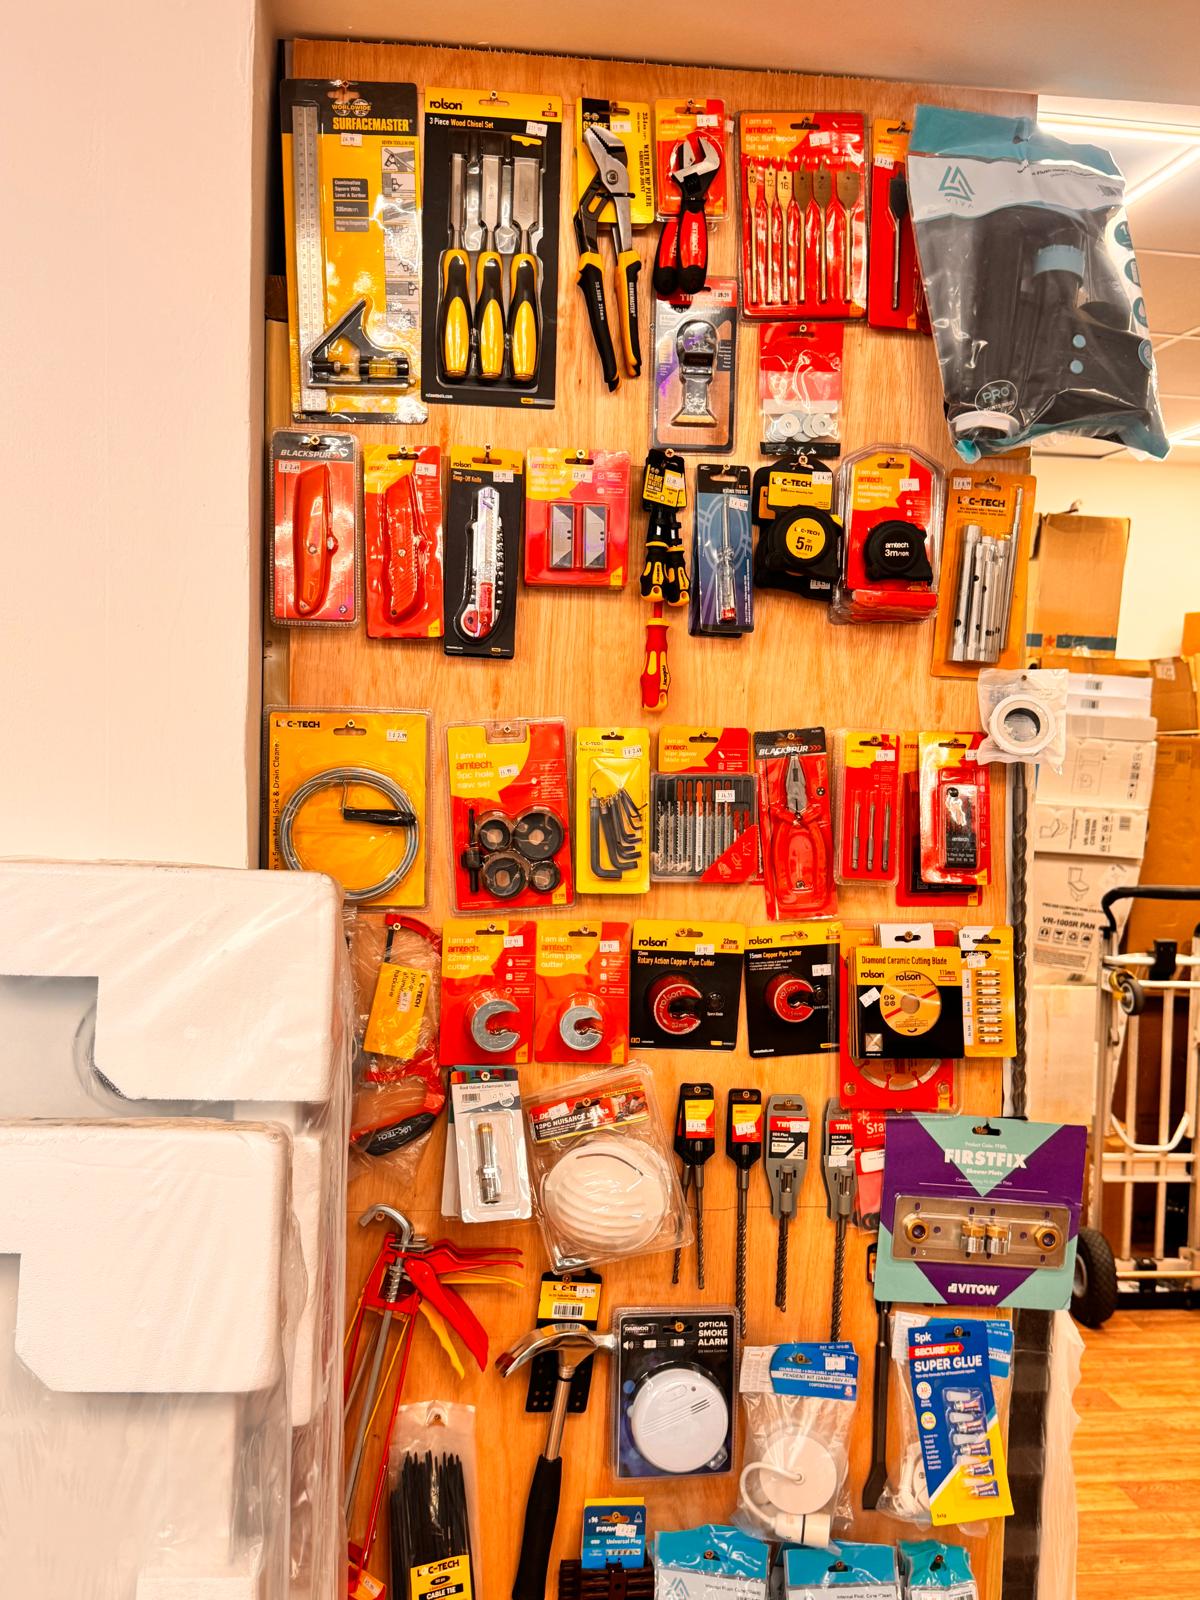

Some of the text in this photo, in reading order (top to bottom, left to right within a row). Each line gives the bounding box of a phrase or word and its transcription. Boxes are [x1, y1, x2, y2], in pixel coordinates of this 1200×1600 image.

[428, 98, 463, 110] rolson
[332, 117, 410, 132] SURFACEMASTER
[434, 117, 450, 126] Piece
[450, 119, 466, 127] Wood
[466, 120, 484, 128] Chisel
[484, 121, 494, 129] Set
[780, 182, 790, 190] 16
[982, 386, 1010, 403] PRO
[280, 449, 332, 459] BLACKSPUR
[884, 541, 909, 549] amtech
[456, 761, 493, 770] amtech
[272, 769, 280, 789] Drain
[272, 798, 280, 814] Sink
[272, 816, 280, 836] Metal
[1079, 920, 1096, 930] PAN
[638, 936, 668, 947] rolson
[748, 936, 773, 946] rolson
[447, 945, 480, 953] amtech
[541, 944, 572, 952] amtech
[762, 951, 778, 960] Copper
[778, 951, 789, 959] Pipe
[861, 955, 948, 966] Diamond Ceramic Cutting Blade
[638, 956, 716, 967] Rotary Action Copper Pipe Cutter
[860, 969, 885, 979] rolson
[895, 972, 921, 981] rolson
[552, 1112, 586, 1127] NUISANCE
[944, 1148, 1028, 1169] FIRSTFIX
[957, 1283, 998, 1296] VITOW
[698, 1329, 728, 1338] SMOKE
[914, 1332, 932, 1344] 5pk
[698, 1338, 728, 1346] ALARM
[914, 1344, 960, 1356] SECUREFIX
[914, 1354, 983, 1373] SUPER GLUE
[631, 1538, 642, 1547] Plug
[426, 1586, 457, 1600] CABLE TIE
